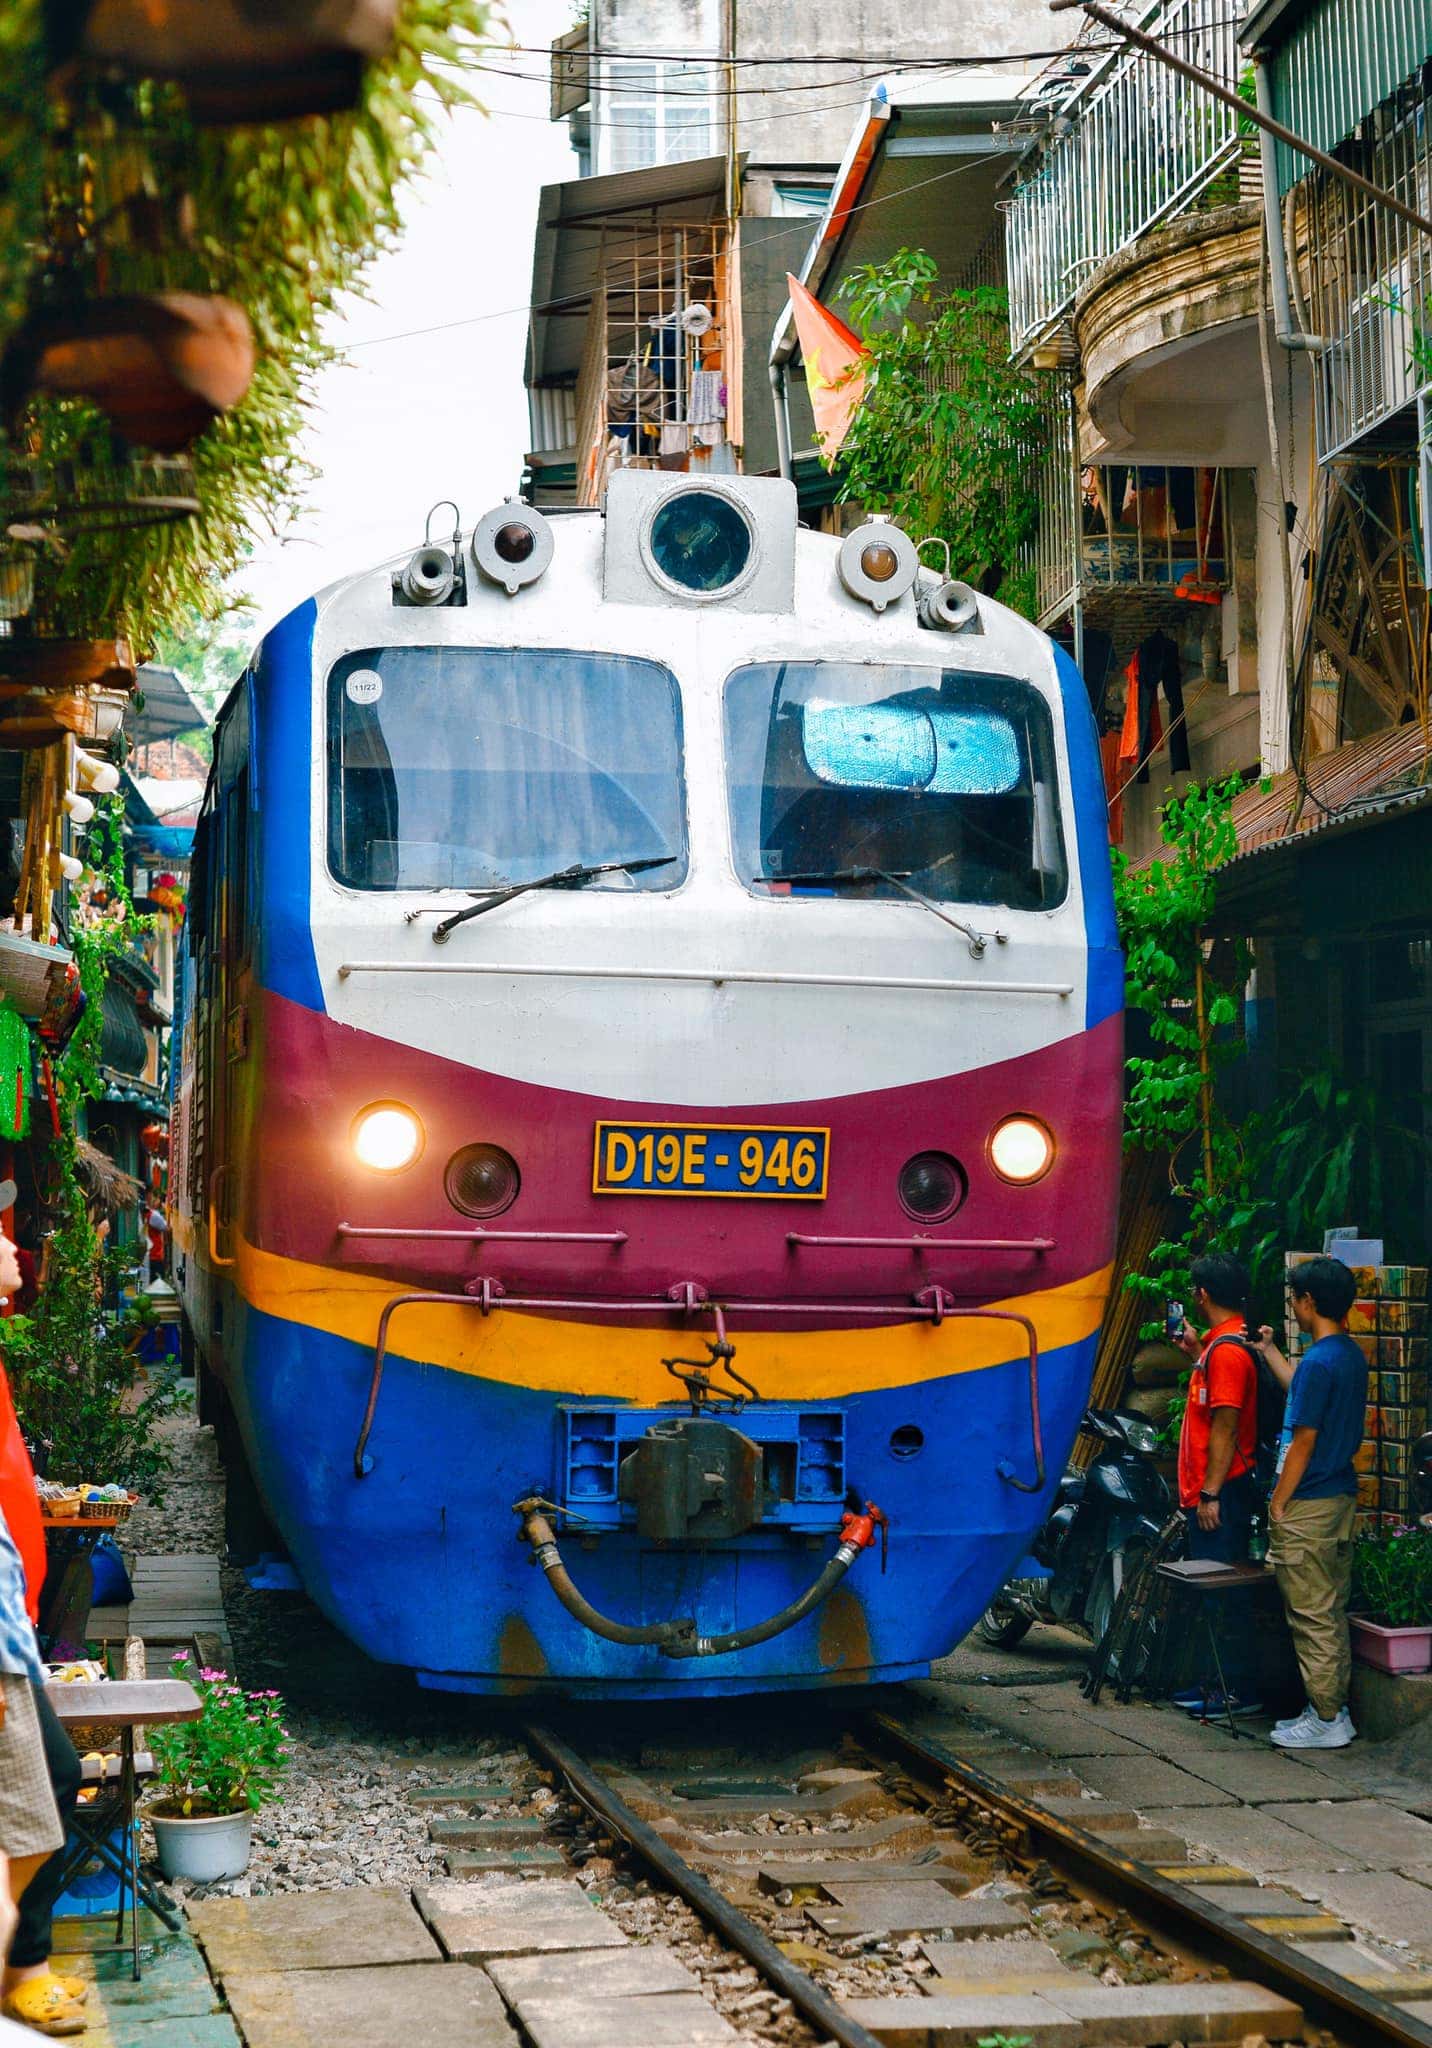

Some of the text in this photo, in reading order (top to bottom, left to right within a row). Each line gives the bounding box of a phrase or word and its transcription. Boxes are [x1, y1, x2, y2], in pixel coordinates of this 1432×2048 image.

[354, 683, 377, 692] 11/22
[605, 1132, 816, 1187] D19E - 946
